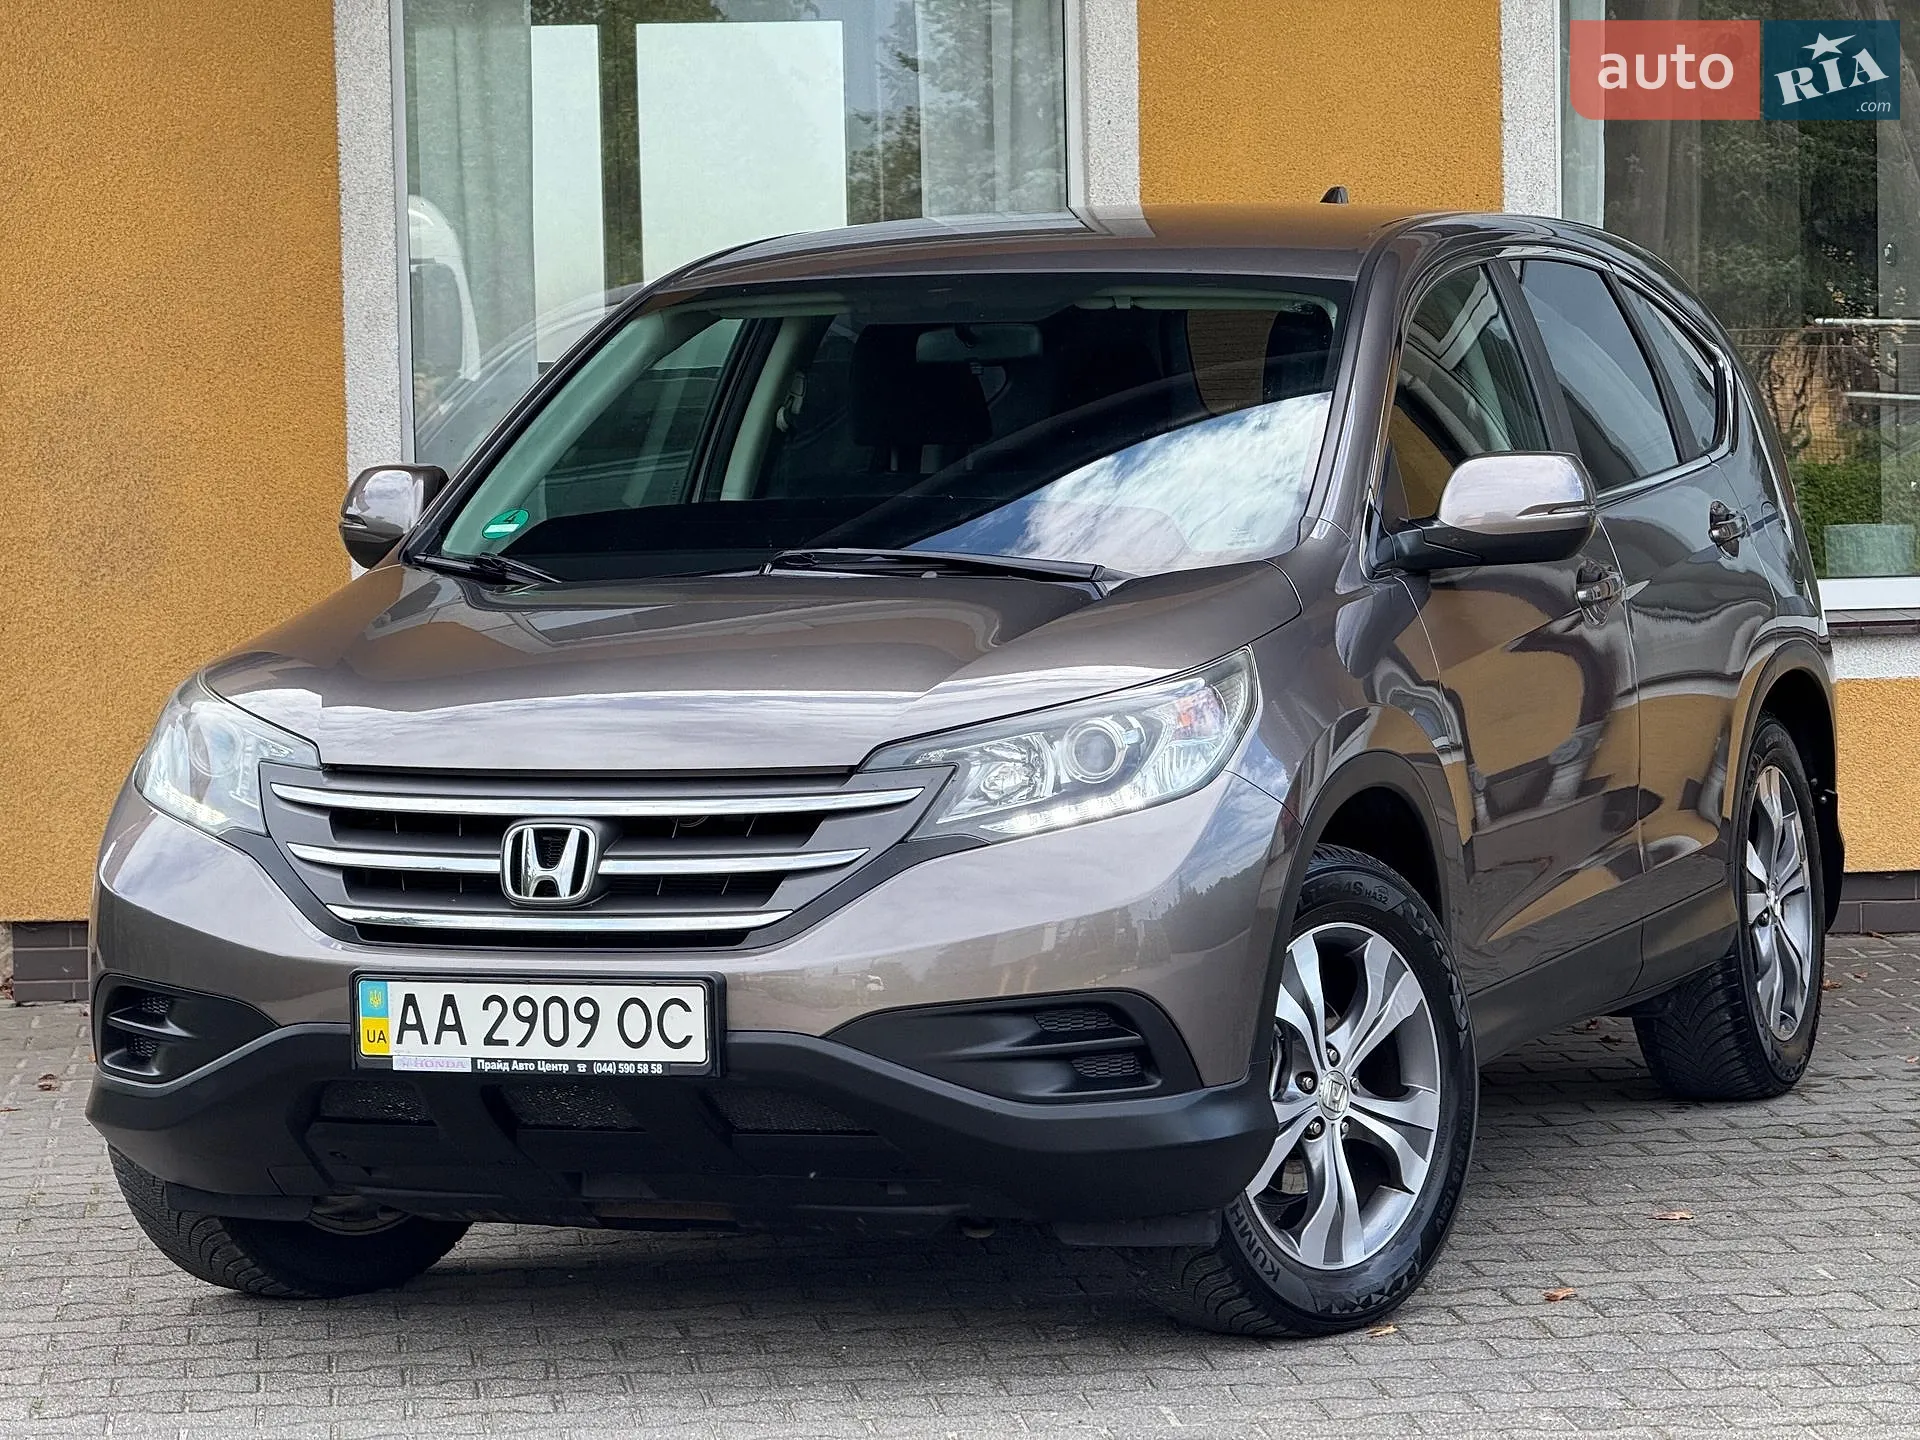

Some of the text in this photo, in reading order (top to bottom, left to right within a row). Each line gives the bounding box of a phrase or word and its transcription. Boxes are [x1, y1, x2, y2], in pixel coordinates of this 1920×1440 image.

[396, 993, 694, 1050] AA 2909 OC
[366, 1029, 387, 1044] UA
[415, 1058, 467, 1069] HONDA
[477, 1059, 663, 1074] Прайд Авто Центр (044) 590 58 58
[1229, 1201, 1280, 1282] KUMH
